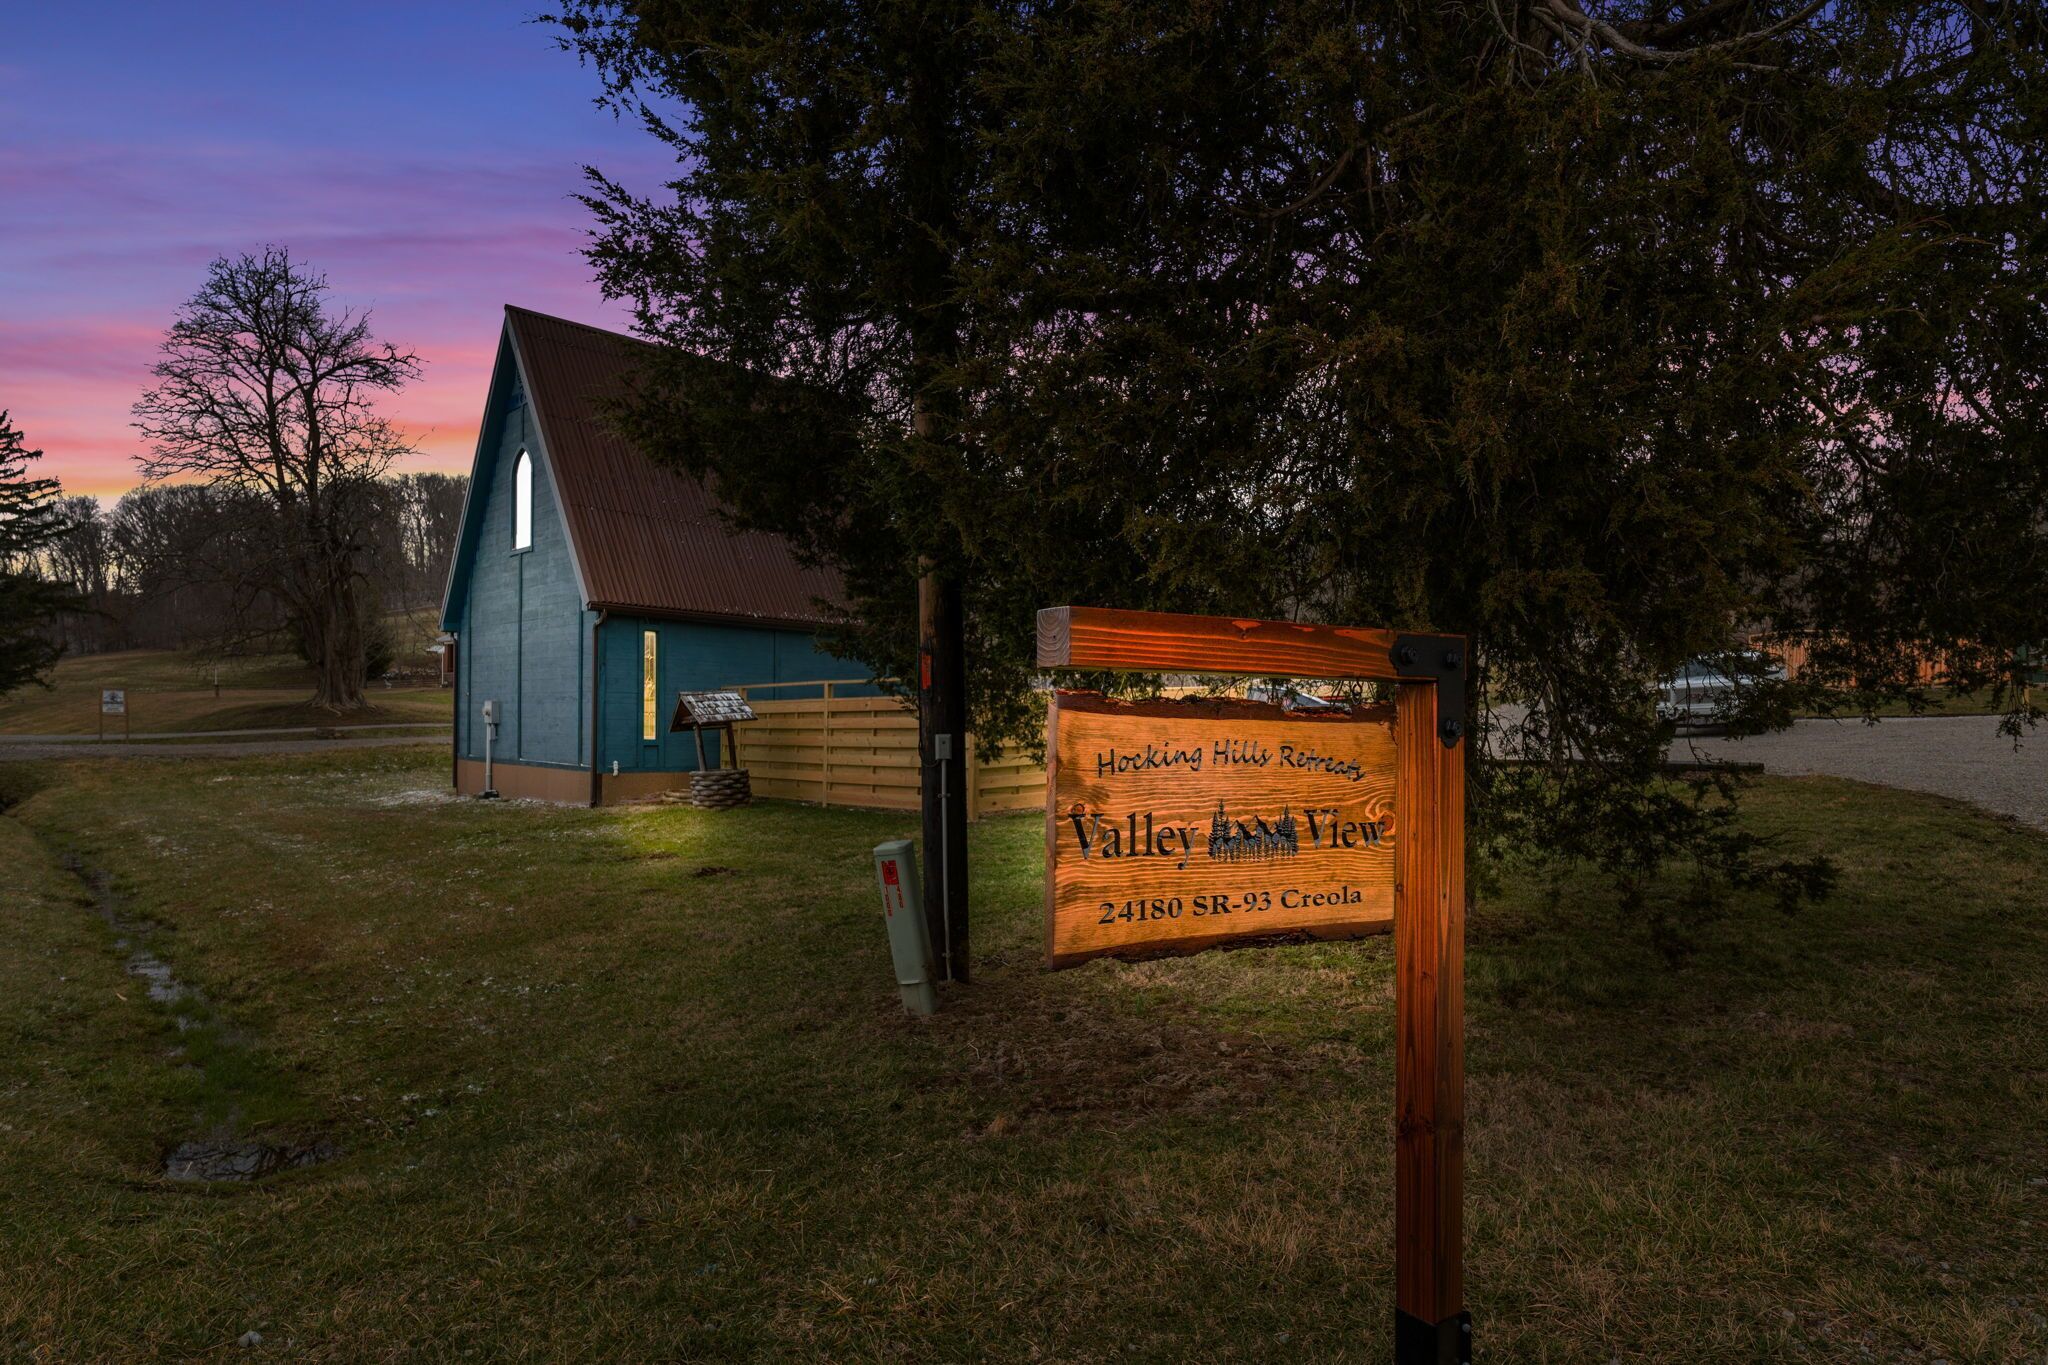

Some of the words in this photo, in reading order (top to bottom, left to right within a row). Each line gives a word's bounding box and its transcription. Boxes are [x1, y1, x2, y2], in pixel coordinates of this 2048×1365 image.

[1097, 741, 1202, 778] Hocking
[1213, 739, 1273, 767] Hills
[1068, 812, 1198, 870] Valley
[1304, 809, 1385, 848] View
[1099, 898, 1182, 924] 24180
[1193, 892, 1272, 916] SR-93
[1281, 886, 1361, 908] Creola
